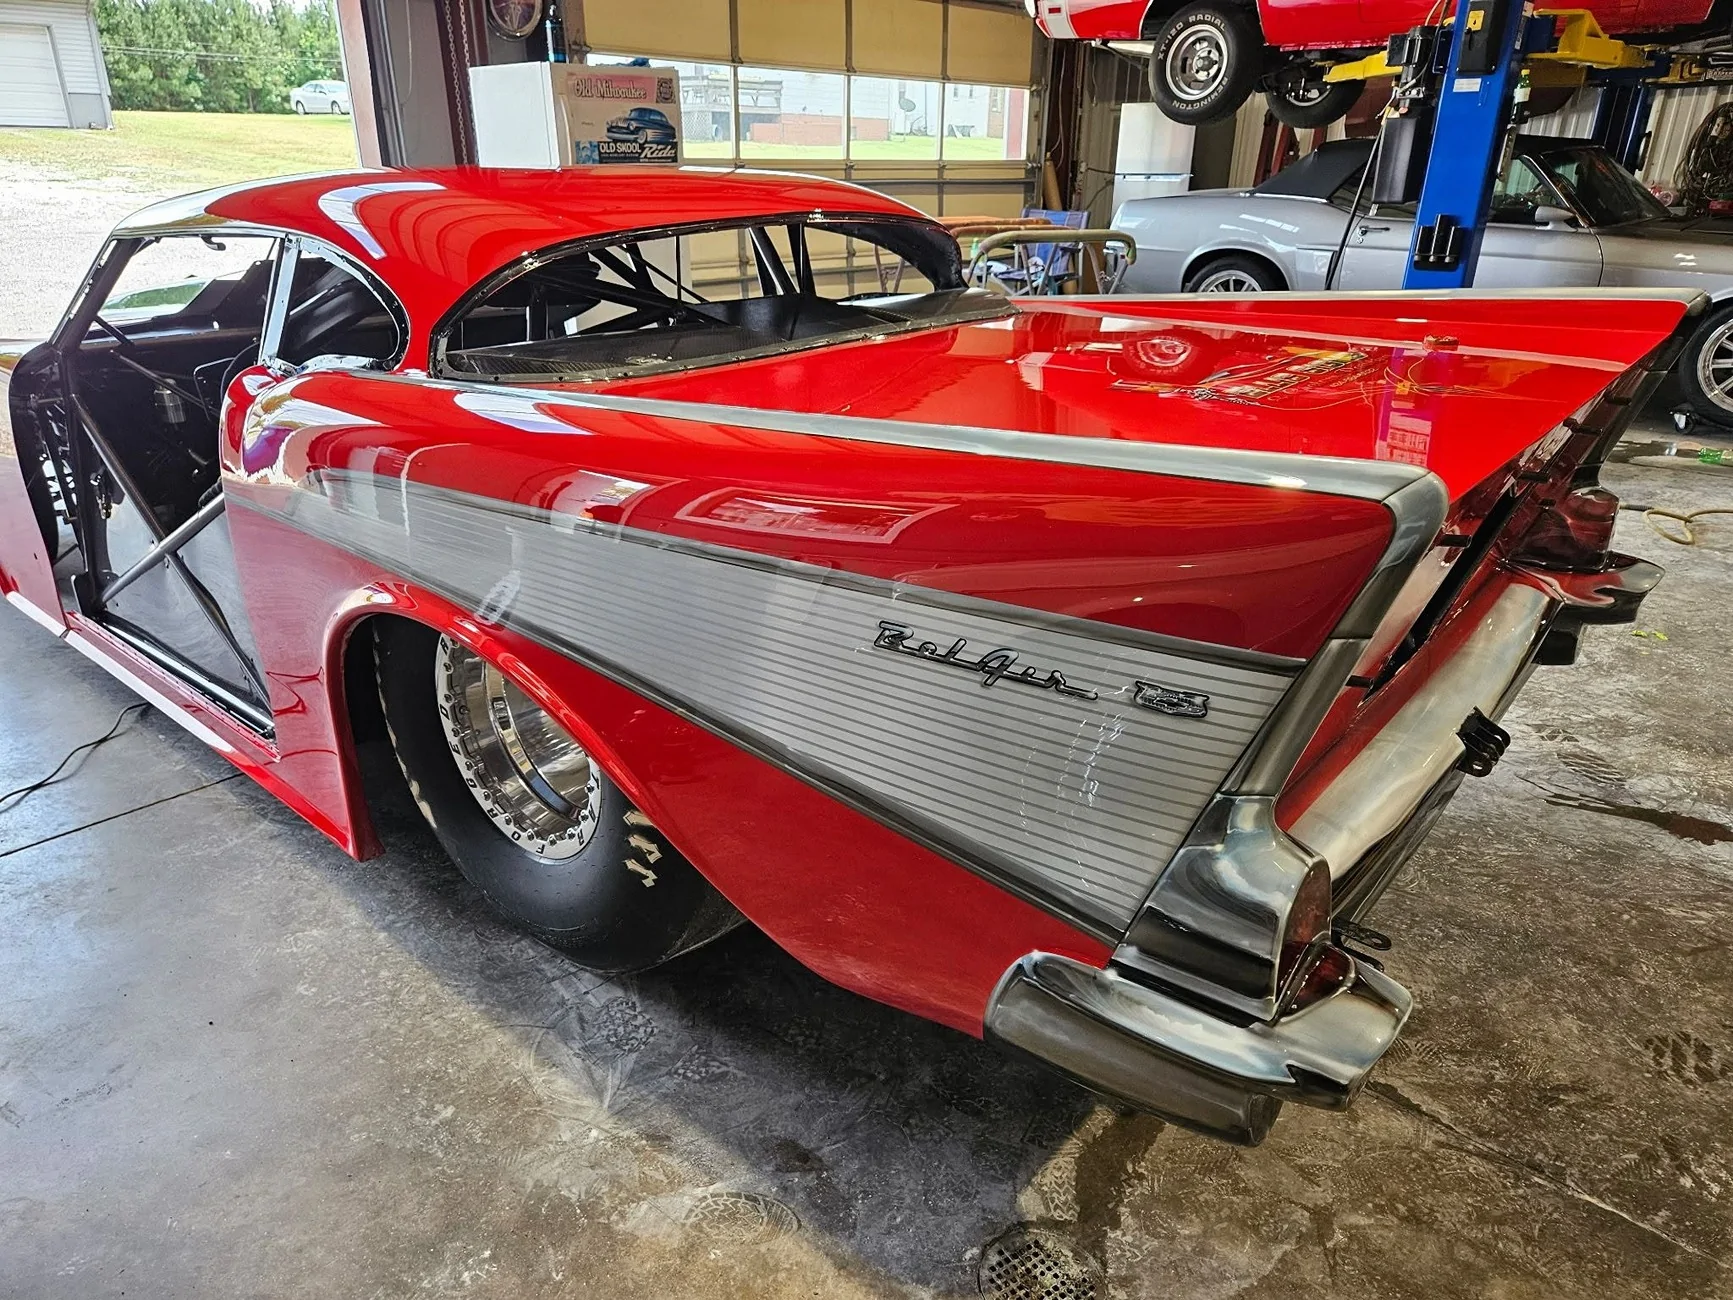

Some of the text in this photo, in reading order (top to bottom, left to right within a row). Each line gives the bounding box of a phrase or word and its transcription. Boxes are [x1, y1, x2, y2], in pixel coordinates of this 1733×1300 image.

[1188, 14, 1225, 31] RADIAL
[575, 79, 594, 98] Old
[596, 79, 647, 100] Milwaukee
[1172, 76, 1229, 110] REMINGTON
[599, 143, 616, 153] OLD
[617, 142, 641, 153] SKOOL
[439, 703, 546, 856] FORGED
